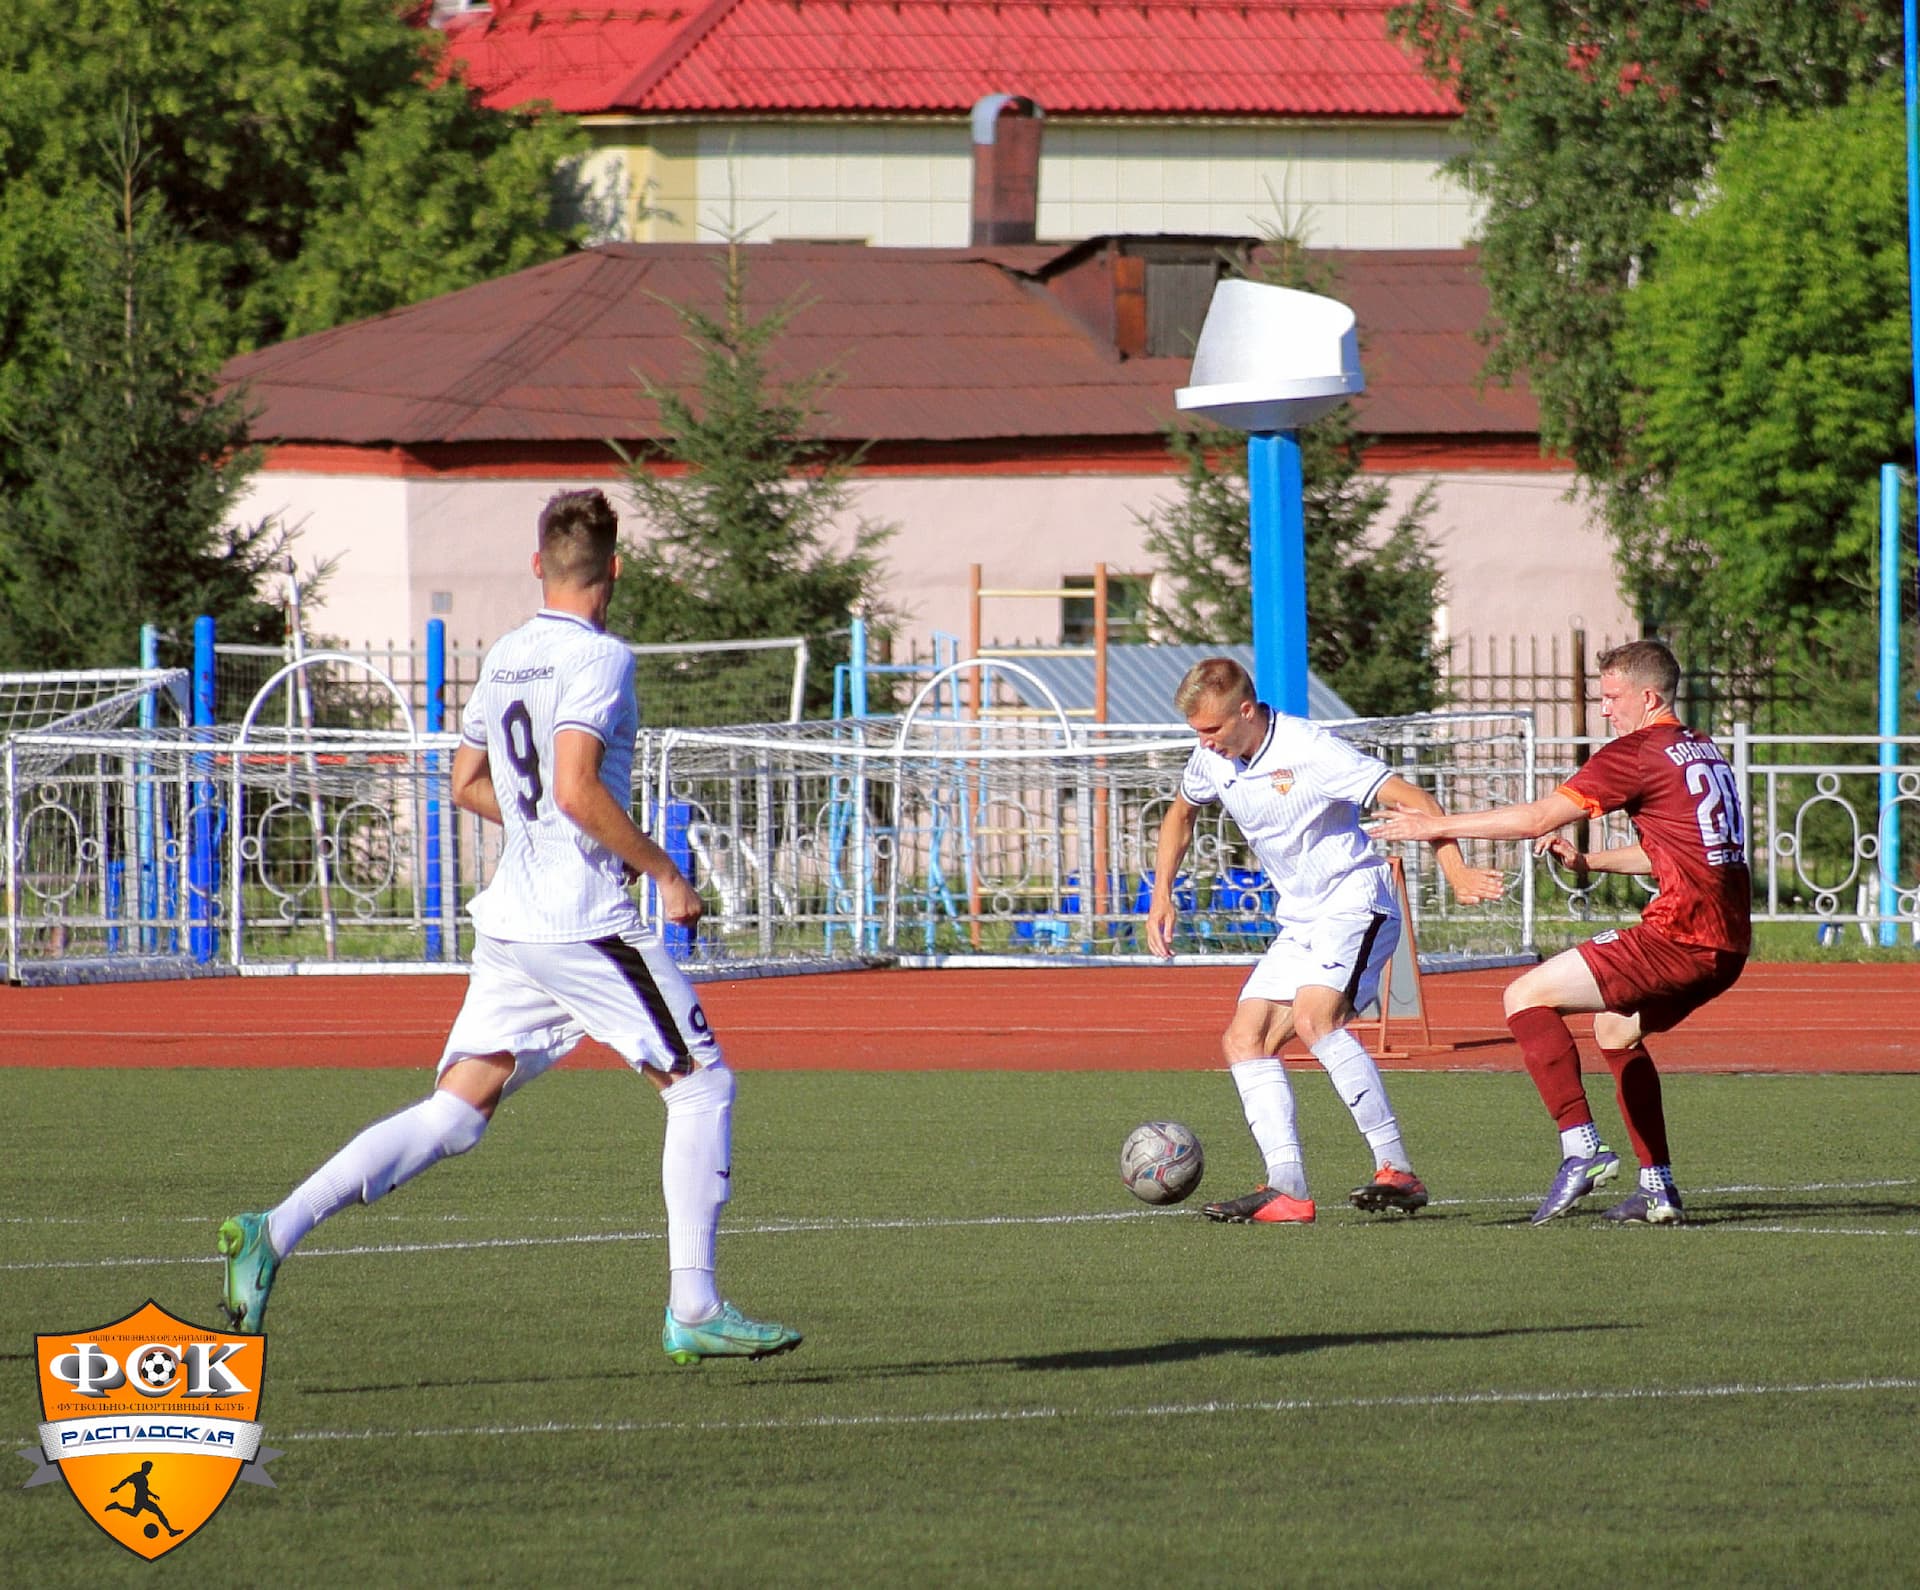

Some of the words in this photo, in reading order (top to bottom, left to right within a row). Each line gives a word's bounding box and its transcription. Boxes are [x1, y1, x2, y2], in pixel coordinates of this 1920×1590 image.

[502, 700, 543, 821] 9
[1686, 763, 1745, 847] 20
[688, 1003, 715, 1047] 9
